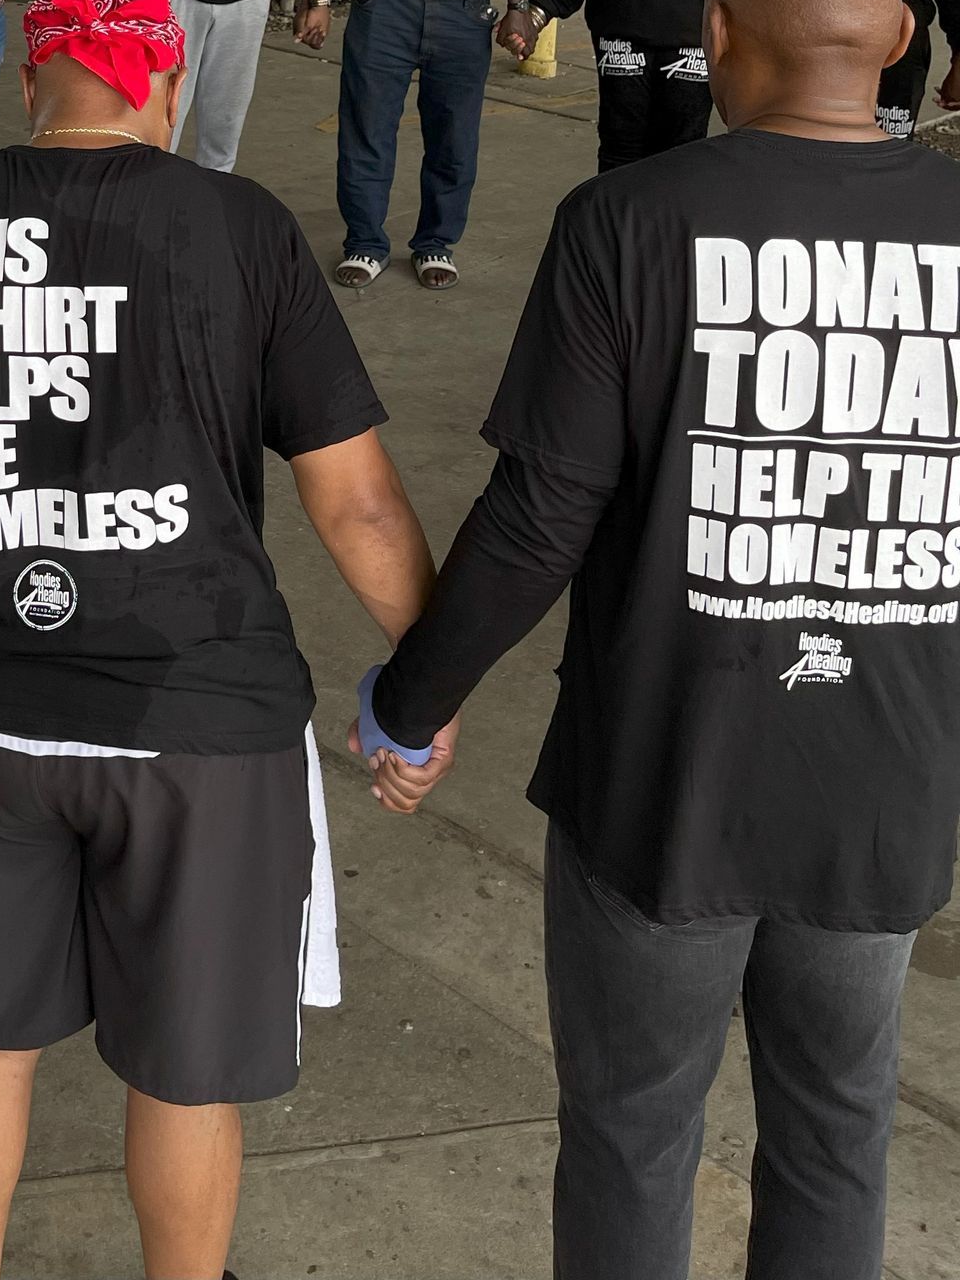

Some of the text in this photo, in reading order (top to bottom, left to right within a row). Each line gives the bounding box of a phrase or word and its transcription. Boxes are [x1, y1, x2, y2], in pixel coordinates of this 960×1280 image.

[600, 36, 632, 54] Hoodies
[608, 51, 647, 67] Healing
[693, 329, 960, 439] TODA
[691, 442, 849, 519] HELP
[29, 570, 61, 590] Hoodies
[38, 585, 69, 608] Healing
[687, 588, 958, 625] www.Hoodies4Healing.org
[798, 631, 843, 655] Hoodies
[779, 649, 852, 691] 4 Healing
